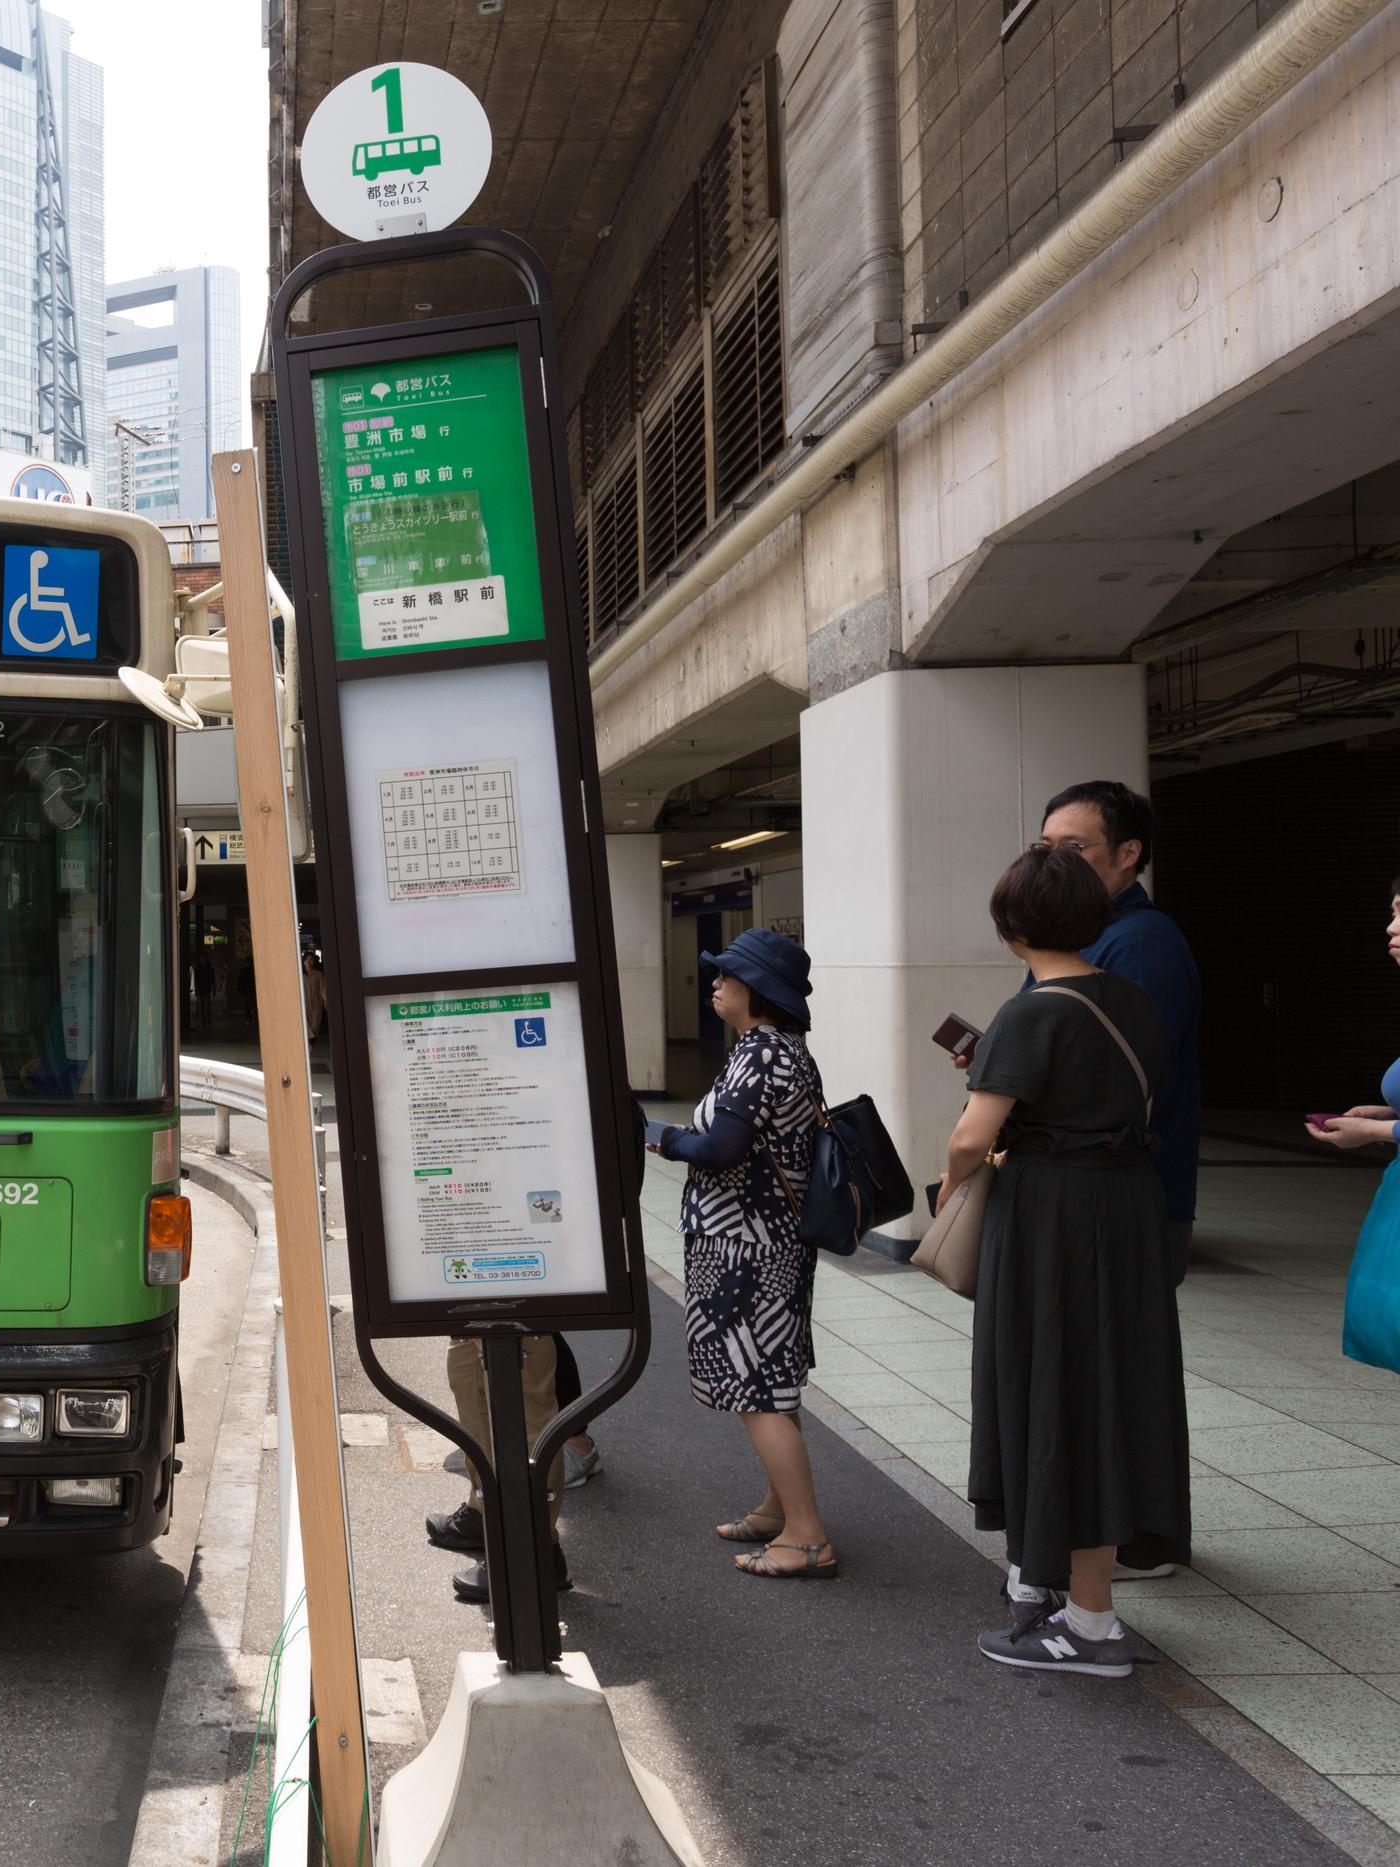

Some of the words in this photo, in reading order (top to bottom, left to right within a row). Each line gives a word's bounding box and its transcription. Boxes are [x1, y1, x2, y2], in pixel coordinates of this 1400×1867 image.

[371, 68, 404, 134] 1
[367, 180, 430, 200] 都営バス
[377, 197, 400, 208] Toei
[403, 195, 422, 206] Bus
[395, 374, 452, 393] 都営バス
[344, 424, 426, 449] 豊洲市場
[439, 425, 451, 437] 行
[348, 466, 453, 493] 市場前駅前
[462, 467, 473, 479] 行
[402, 585, 495, 609] 新橋駅前
[409, 1000, 508, 1015] 都営バス利用上のお願い
